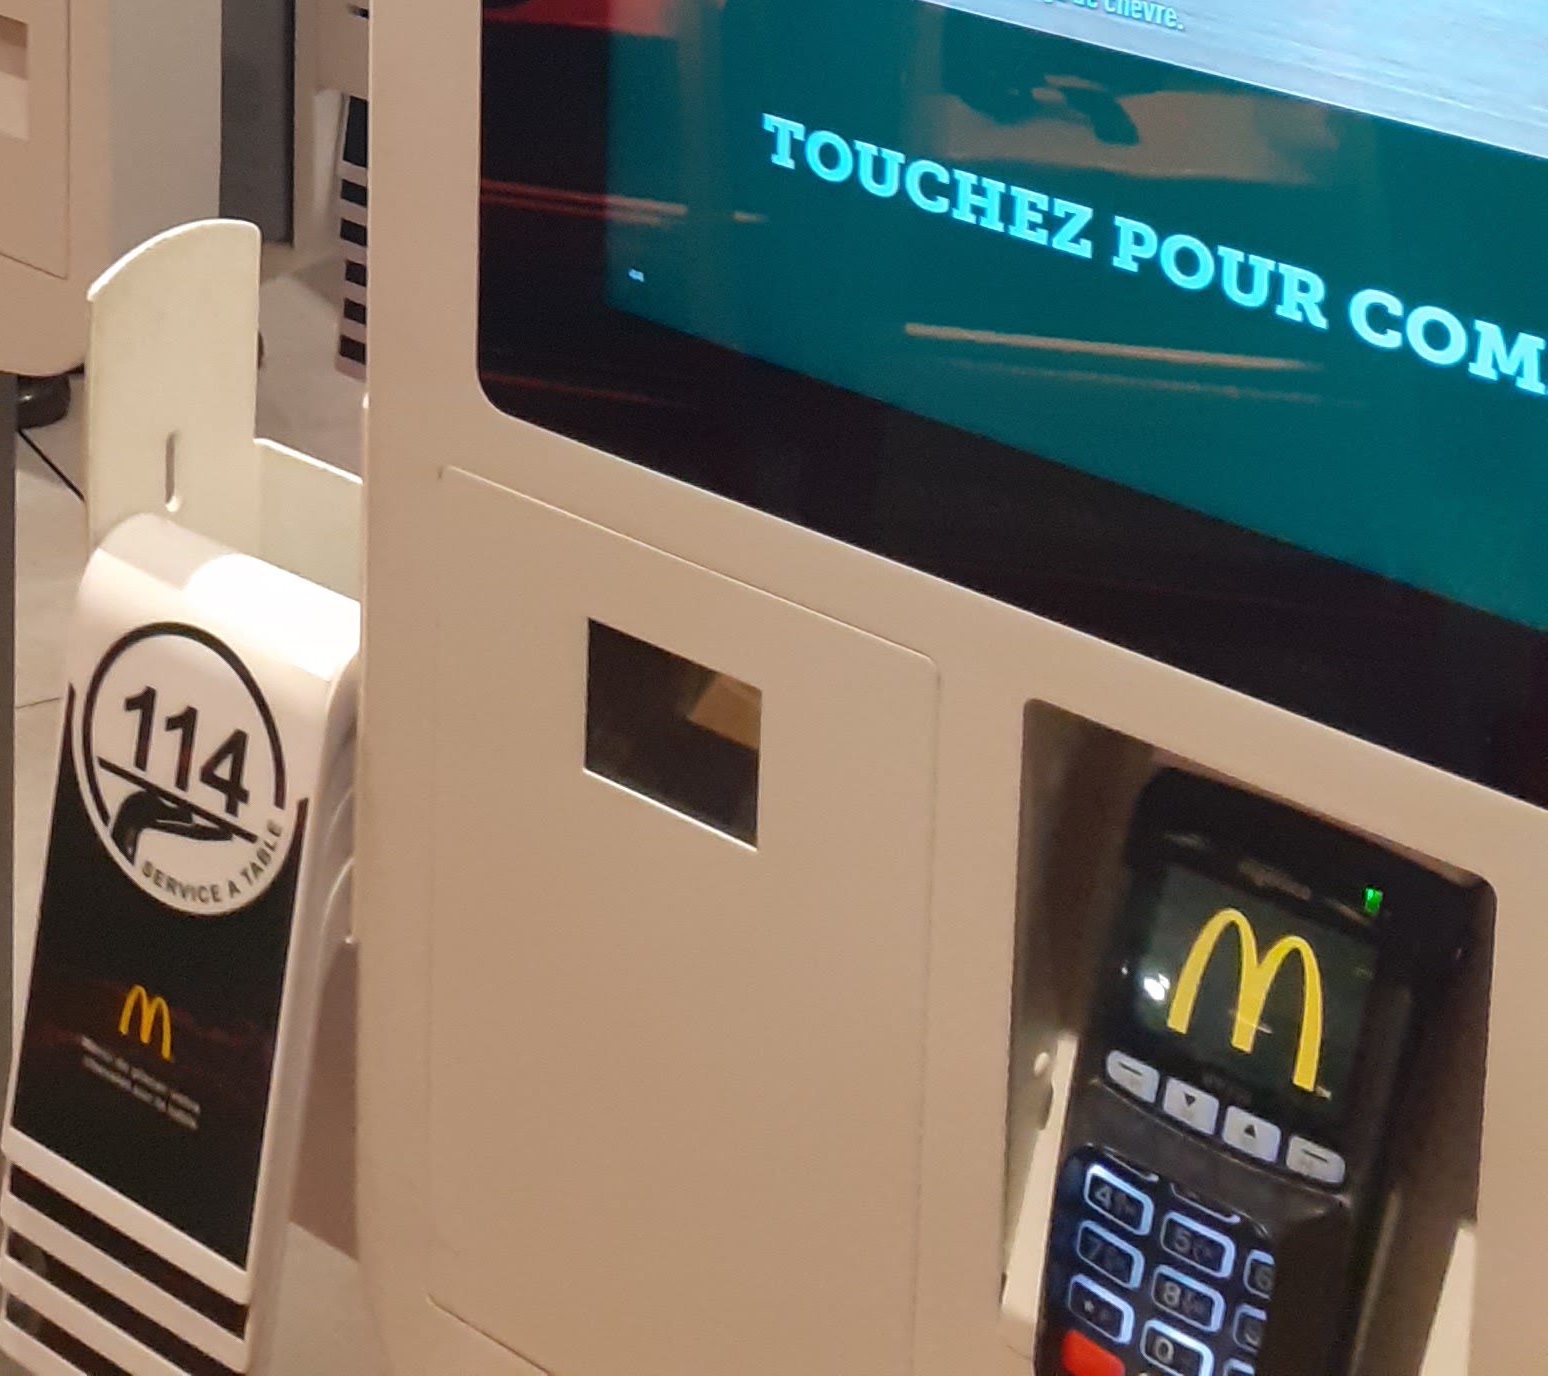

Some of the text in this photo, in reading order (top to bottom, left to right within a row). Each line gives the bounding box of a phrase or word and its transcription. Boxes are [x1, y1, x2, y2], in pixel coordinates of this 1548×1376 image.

[761, 113, 1094, 259] TOUCHEZ
[1112, 214, 1329, 330] POUR
[124, 686, 250, 818] 114
[141, 860, 222, 904] SERVICE
[241, 818, 284, 885] TABLE
